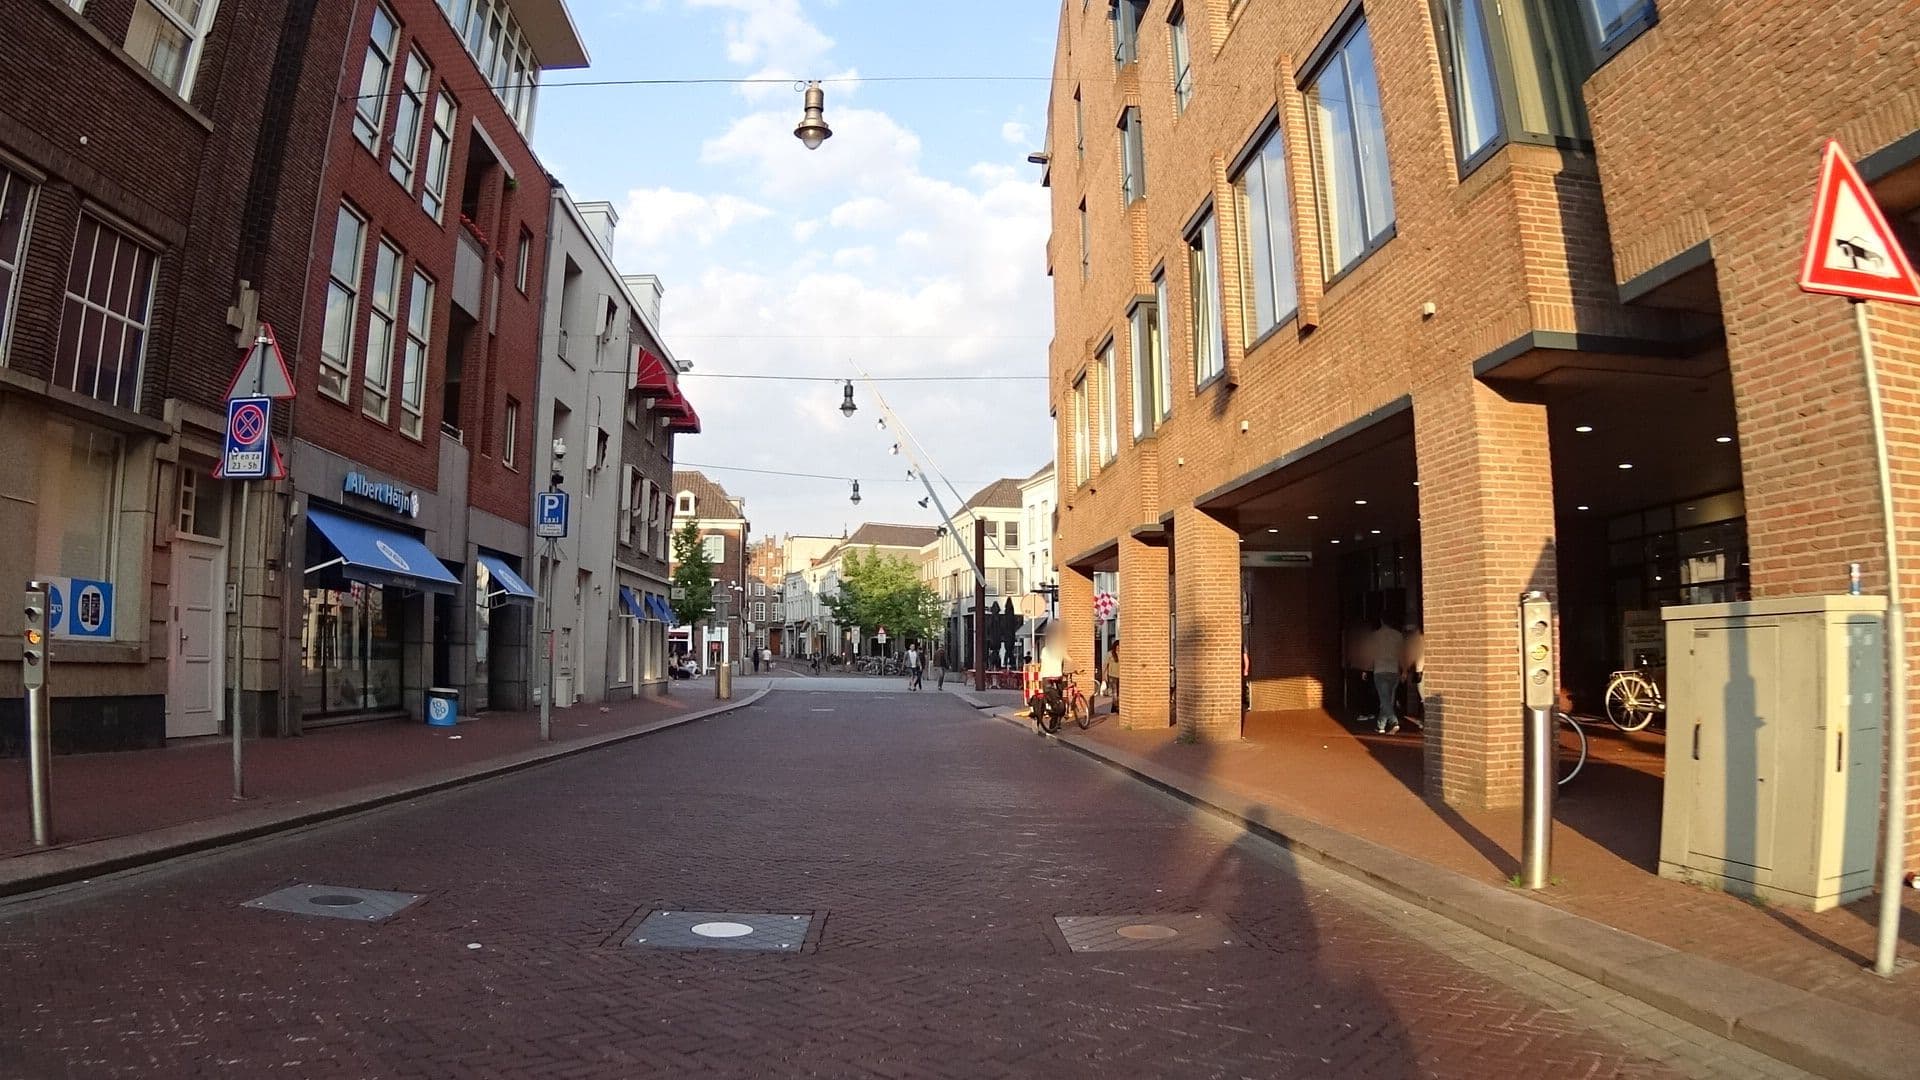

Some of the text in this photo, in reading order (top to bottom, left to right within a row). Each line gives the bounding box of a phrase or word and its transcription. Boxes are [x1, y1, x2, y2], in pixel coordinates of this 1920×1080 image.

[345, 472, 384, 501] Albert
[384, 484, 410, 514] Heijn
[544, 495, 560, 517] P
[543, 516, 559, 524] taxi
